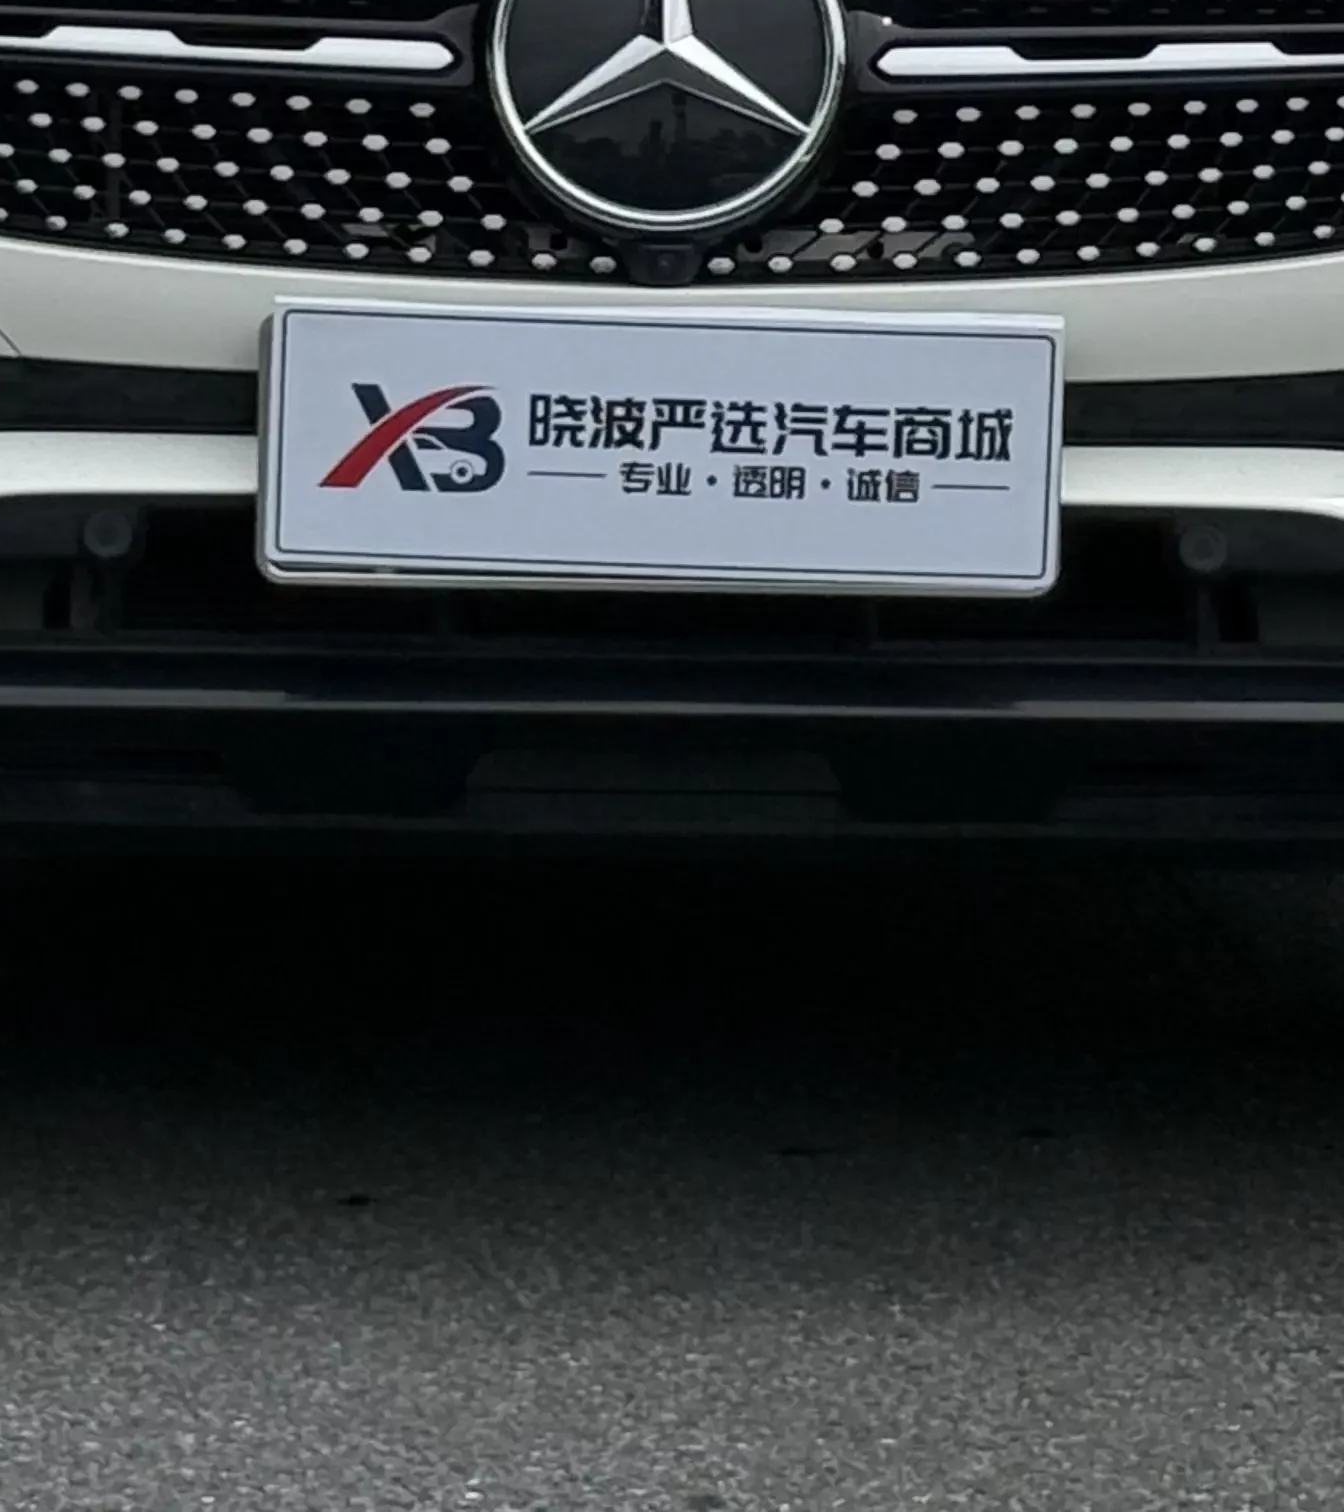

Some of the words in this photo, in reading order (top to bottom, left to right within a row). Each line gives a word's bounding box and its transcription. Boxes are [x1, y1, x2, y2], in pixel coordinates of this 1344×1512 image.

[528, 393, 1014, 462] 晓波严选汽车商城
